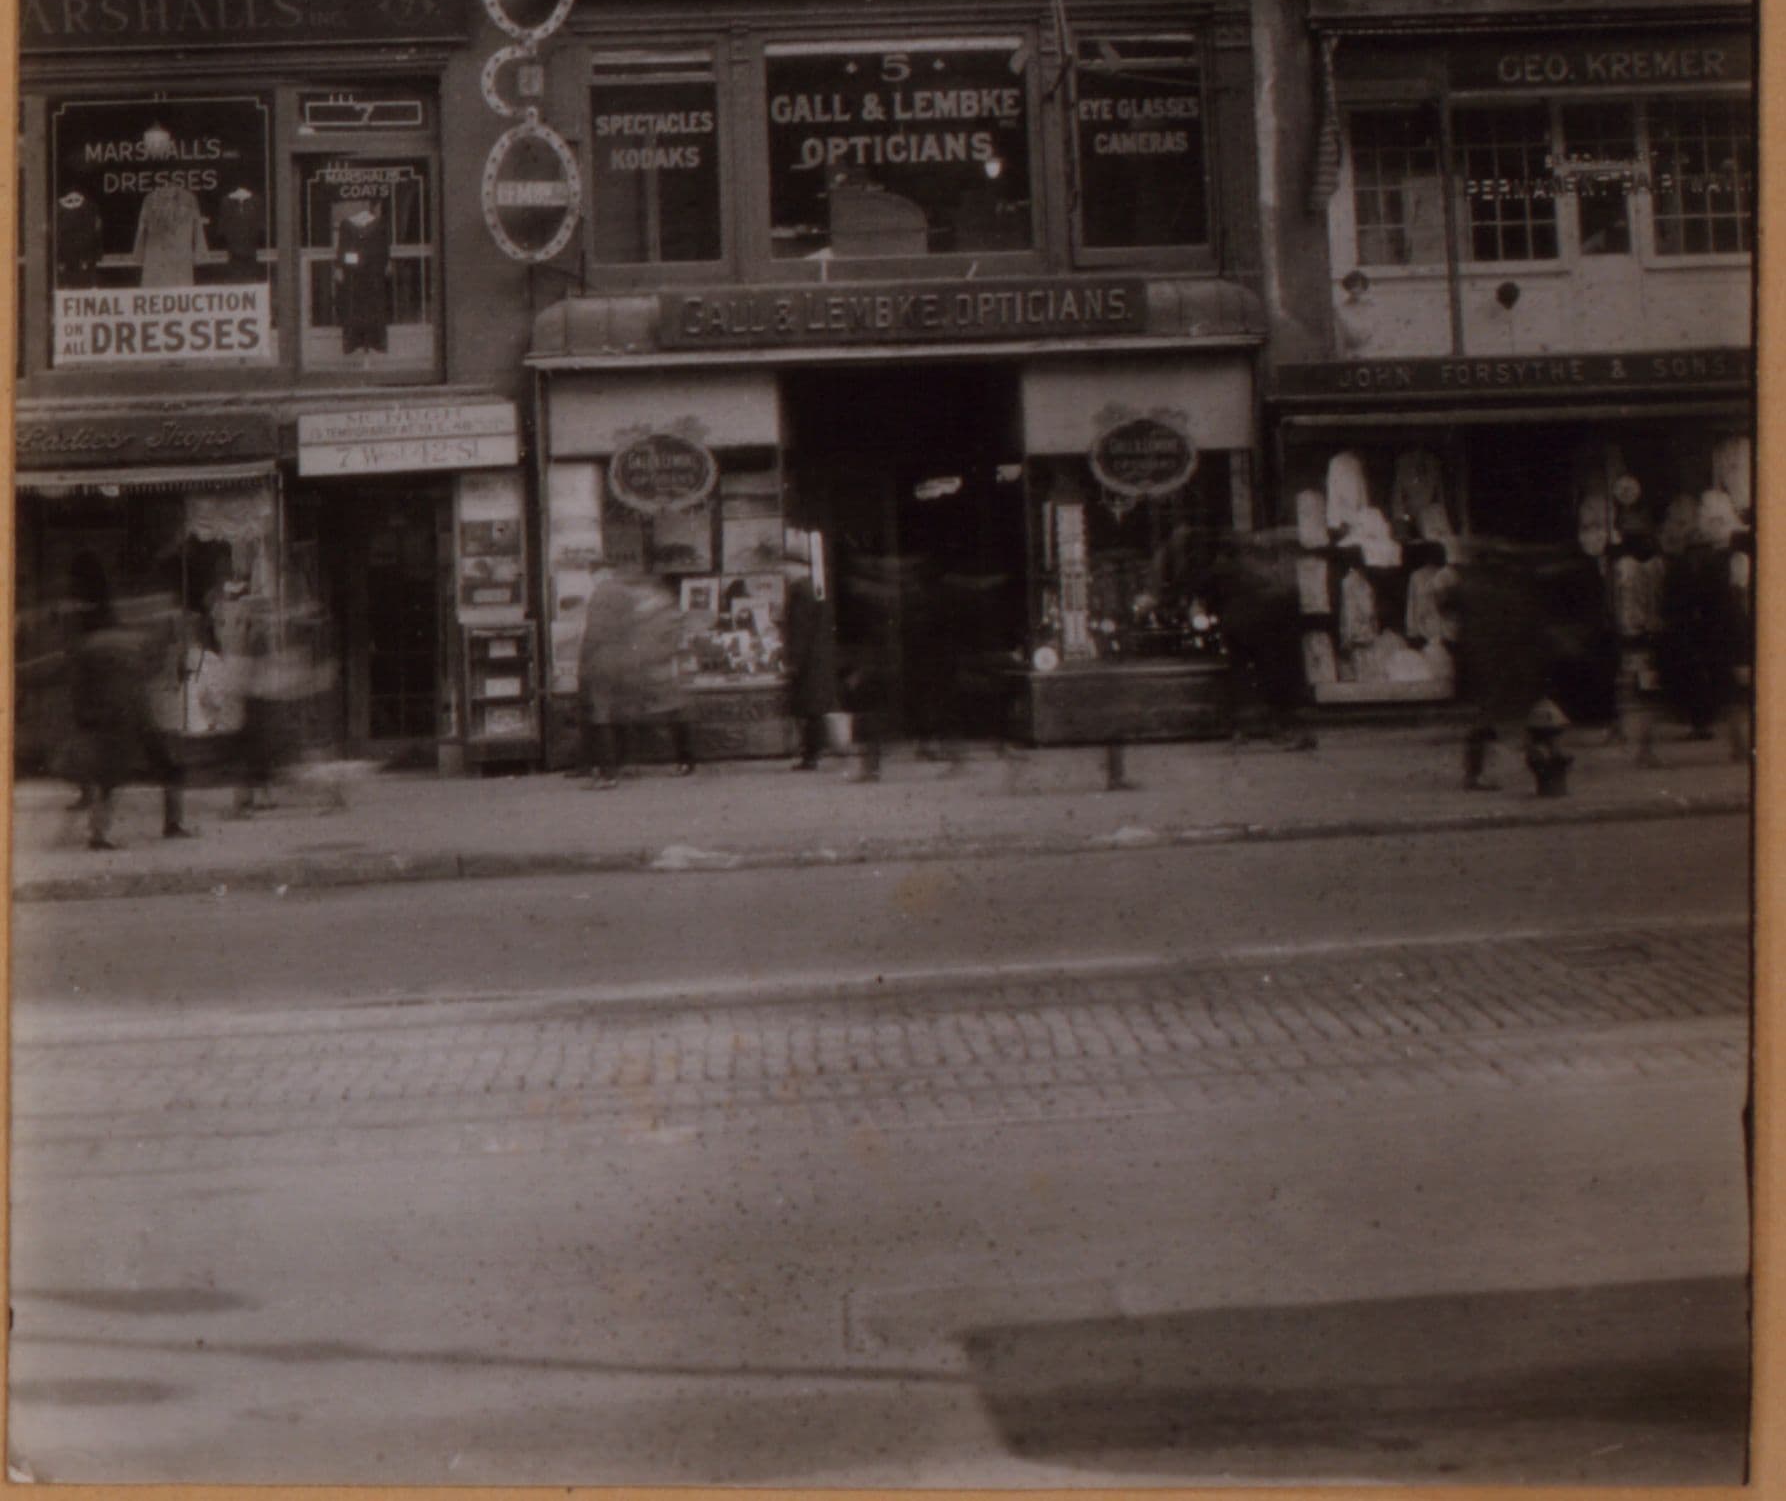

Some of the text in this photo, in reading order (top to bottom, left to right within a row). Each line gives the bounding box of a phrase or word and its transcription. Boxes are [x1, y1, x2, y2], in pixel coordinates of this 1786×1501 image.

[880, 53, 912, 82] 5
[1497, 49, 1727, 83] GEO. KREMER
[353, 102, 375, 126] 7
[770, 87, 1022, 124] GALL & LEMBKE
[1078, 96, 1199, 122] EYE GLASSES
[595, 112, 714, 136] SPECTACLES
[789, 131, 993, 172] OPTICIANS
[1093, 130, 1189, 155] CAMERAS
[610, 146, 700, 170] KODAKS
[103, 169, 218, 194] DRESSES
[339, 185, 390, 199] COATS
[62, 291, 257, 317] FINAL REDUCTION
[683, 296, 766, 335] GALL
[63, 319, 260, 356] ALL DRESSES
[1440, 358, 1584, 385] FORSYTHE
[1607, 360, 1628, 380] &
